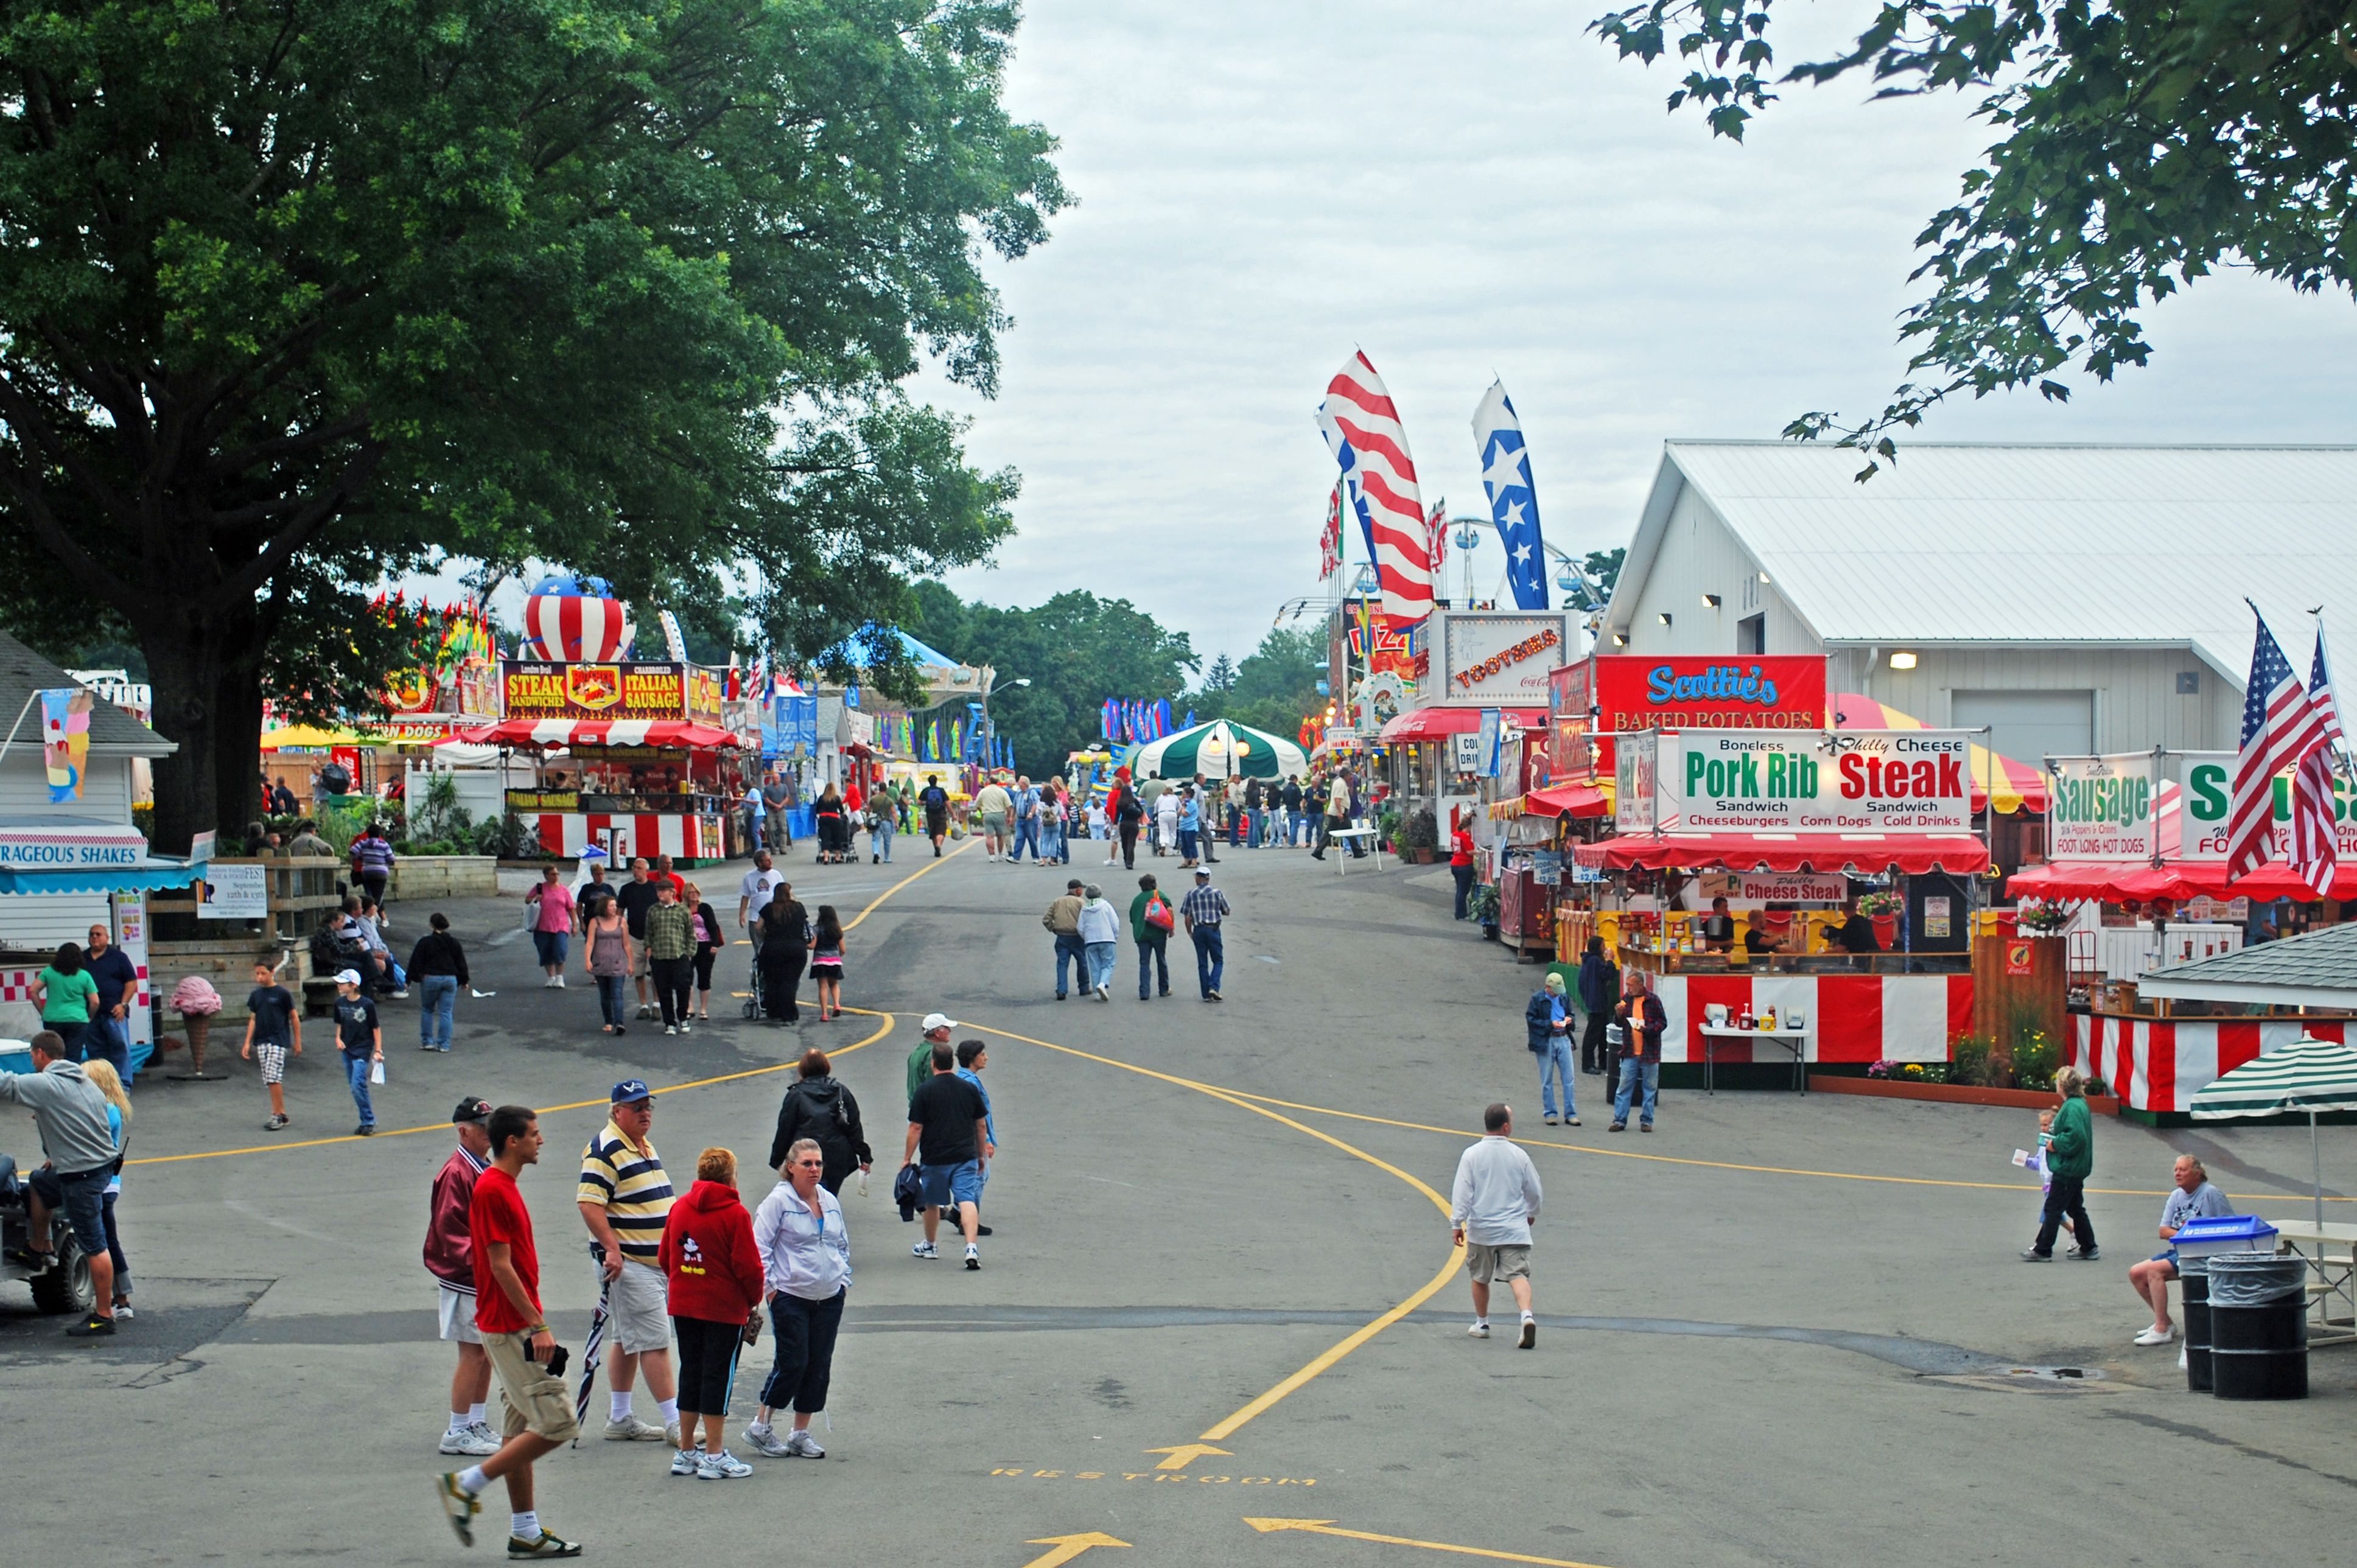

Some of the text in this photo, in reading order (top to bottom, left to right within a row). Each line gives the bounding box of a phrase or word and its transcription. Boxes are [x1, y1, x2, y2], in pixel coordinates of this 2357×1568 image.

[1455, 629, 1557, 688] TOOTSIES
[508, 674, 565, 696] STEAK
[625, 675, 678, 691] ITALIAN
[1647, 665, 1779, 707] Scottie's
[510, 696, 565, 707] SANDWICHES
[626, 692, 681, 709] SAUSAGE
[1613, 712, 1813, 730] BAKED POTATOES
[404, 726, 443, 738] DOGS
[1720, 740, 1784, 751] Boneless
[1841, 737, 1963, 754] Philly Cheese
[1687, 751, 1759, 798] Pork
[1768, 752, 1818, 799] Rib
[1839, 752, 1963, 800] Steak
[1716, 800, 1788, 812] Sandwich
[1866, 801, 1938, 812] Sandwich
[2056, 774, 2149, 828] Sausage
[1689, 814, 1961, 828] Cheeseburgers Corn Dogs Cold Drinks
[2072, 824, 2092, 836] Peppers
[2098, 824, 2117, 835] Onions
[2058, 838, 2144, 853] FOOT LONG HOT DOGS
[0, 845, 136, 863] RAGEOUS SHAKES
[245, 867, 264, 880] FEST
[1776, 876, 1815, 886] Philly
[251, 891, 265, 900] 13th
[1745, 883, 1842, 900] Cheese Steak
[990, 1468, 1317, 1486] RESTROOM
